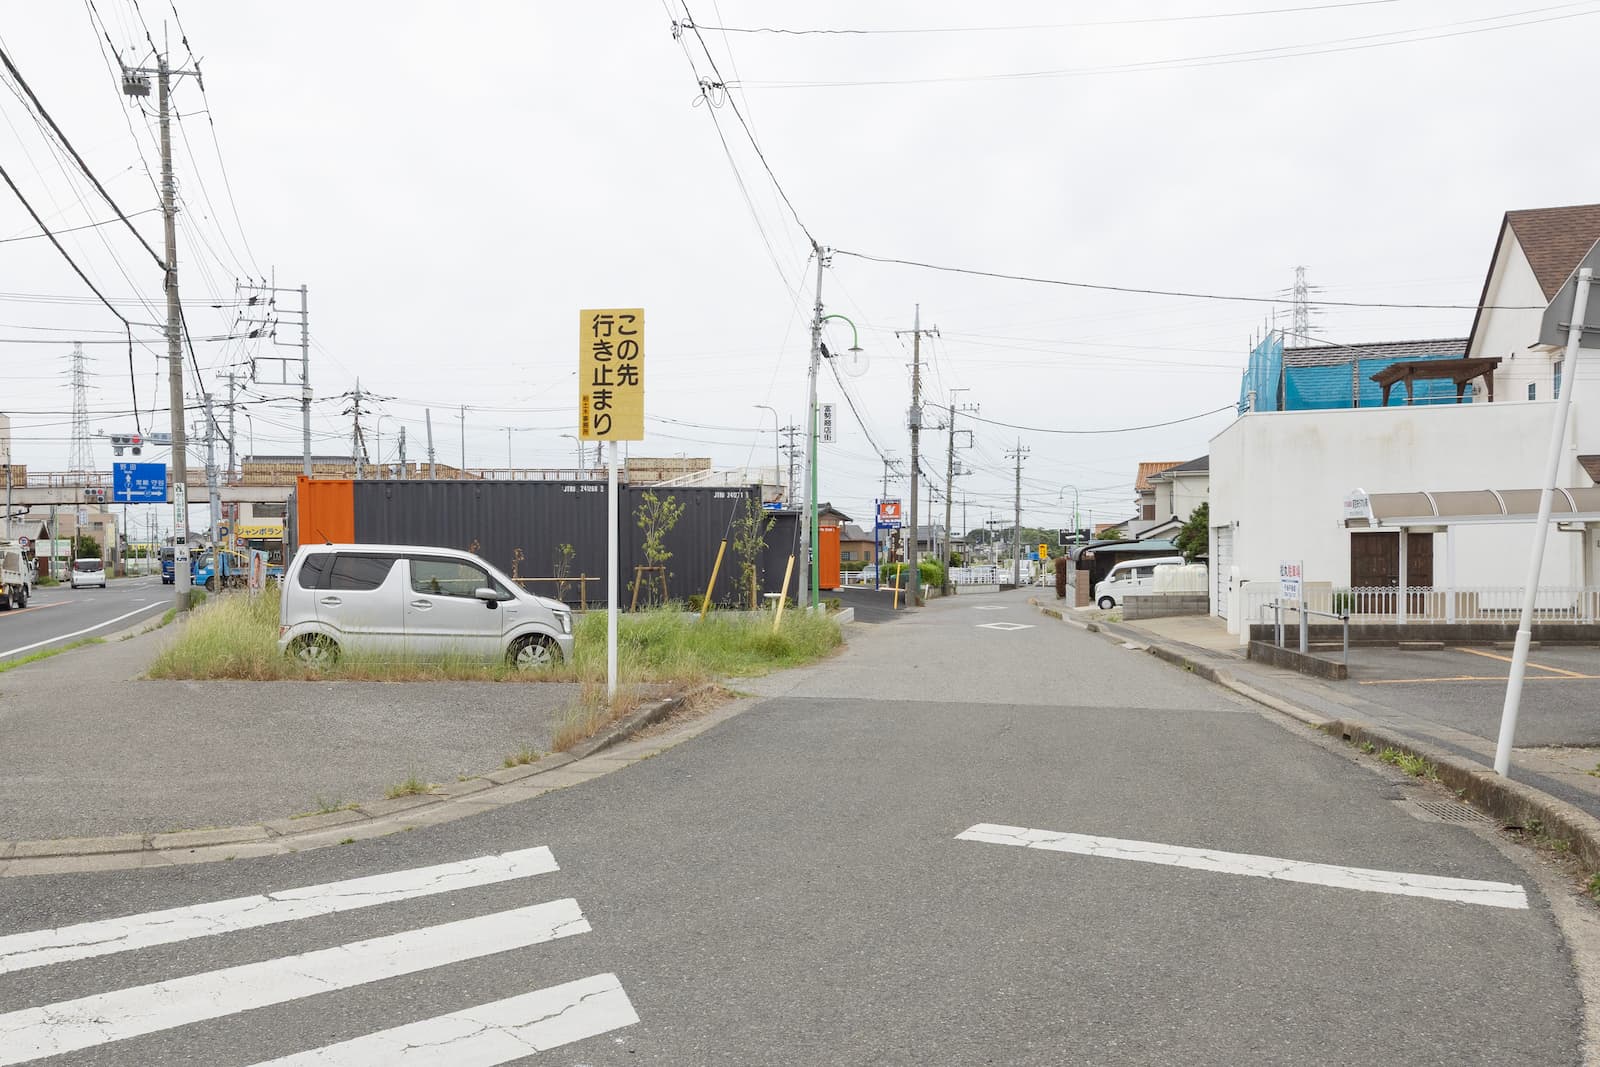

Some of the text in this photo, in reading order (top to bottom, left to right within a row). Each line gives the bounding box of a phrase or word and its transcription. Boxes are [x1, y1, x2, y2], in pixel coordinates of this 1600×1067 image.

[592, 314, 615, 436] 行き止まり
[617, 314, 639, 387] この先
